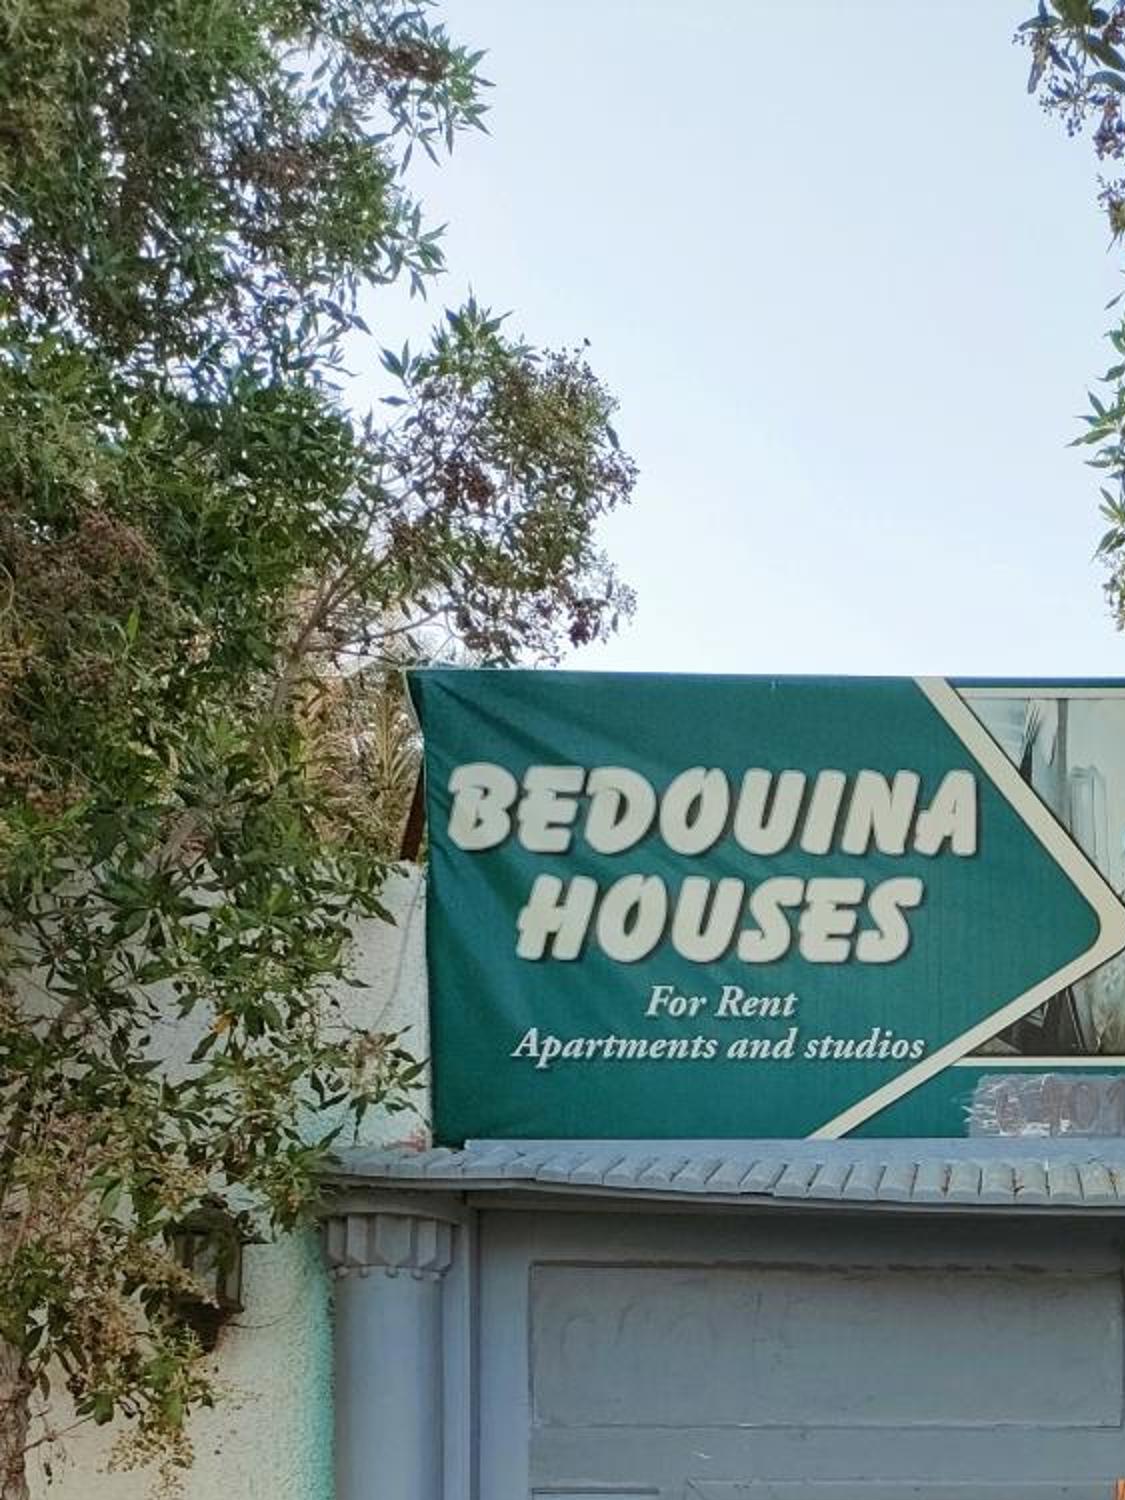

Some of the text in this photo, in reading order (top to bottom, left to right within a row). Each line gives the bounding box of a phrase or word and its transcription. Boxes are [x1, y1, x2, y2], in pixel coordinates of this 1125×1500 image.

[447, 762, 979, 857] BEDOUINA
[516, 874, 924, 964] HOUSES
[646, 985, 799, 1017] For Rent
[511, 1027, 926, 1069] Apartments and studios
